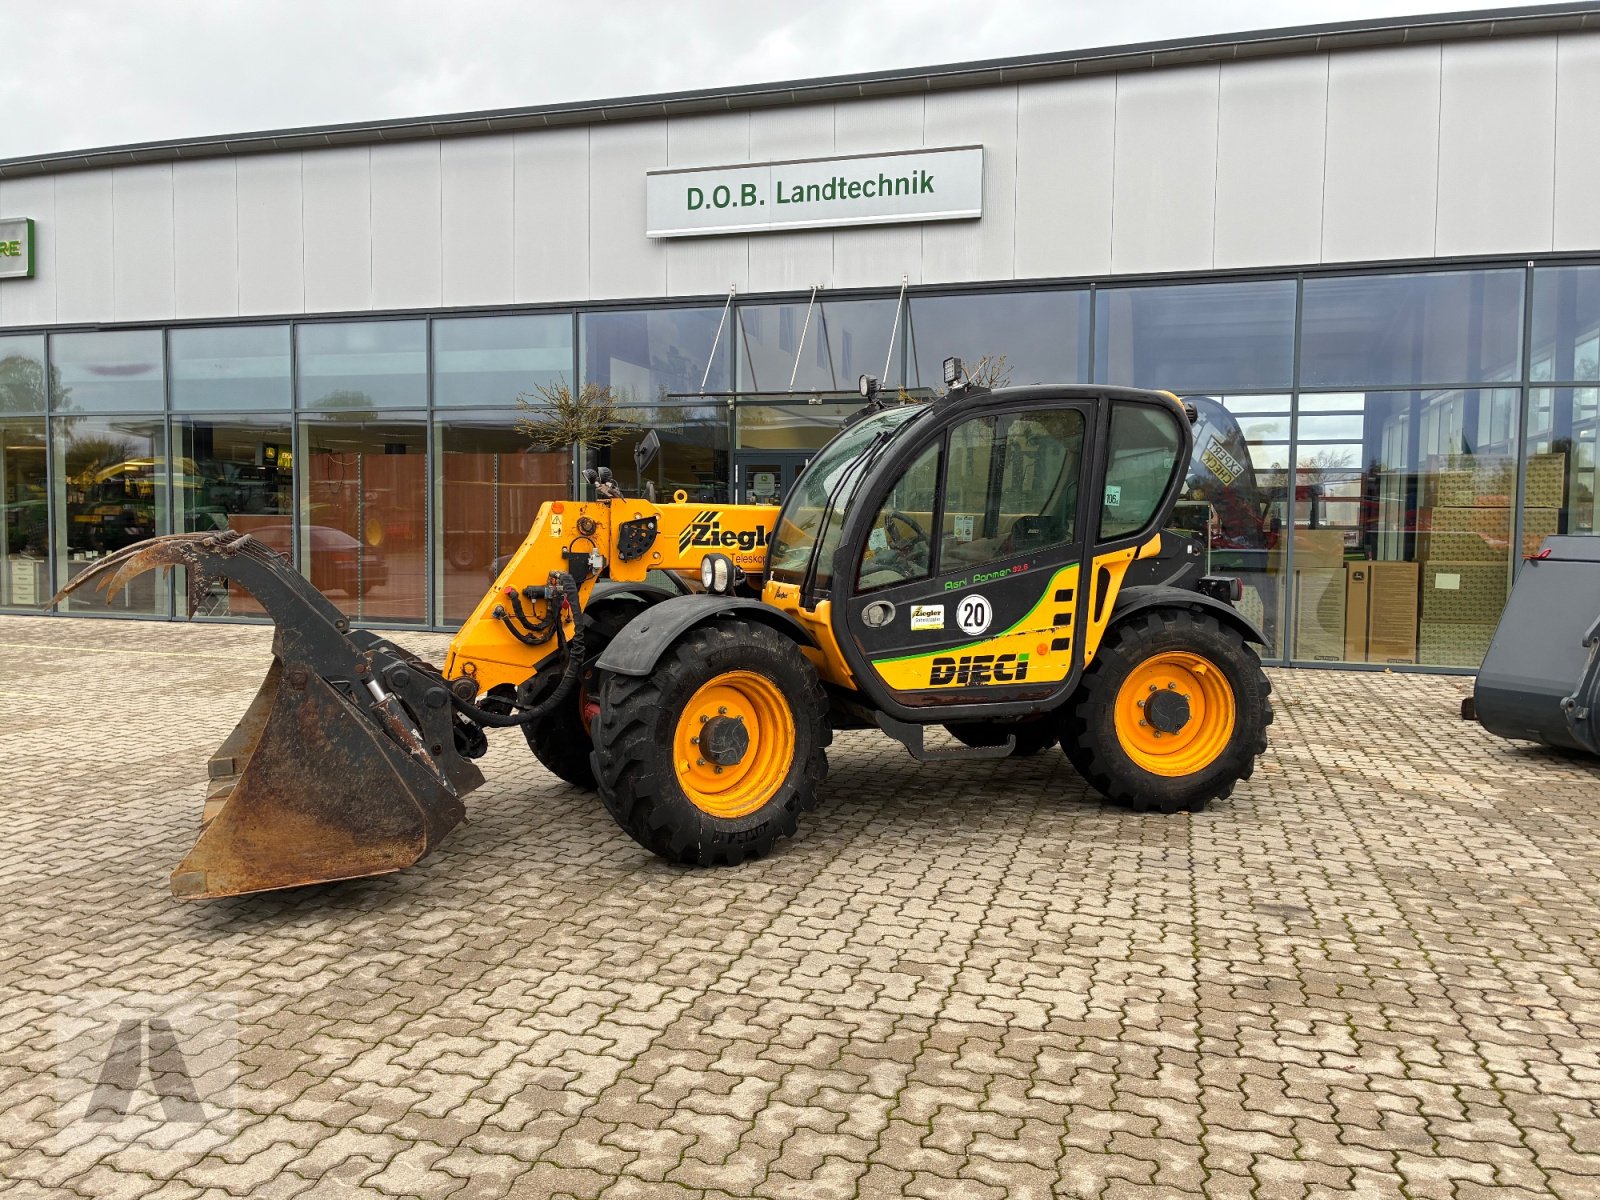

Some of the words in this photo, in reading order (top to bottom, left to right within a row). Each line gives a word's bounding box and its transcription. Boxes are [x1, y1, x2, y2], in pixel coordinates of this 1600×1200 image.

[687, 183, 765, 210] D.O.B.
[776, 169, 935, 204] Landtechnik
[915, 610, 942, 618] Ziegler
[964, 602, 985, 627] 20
